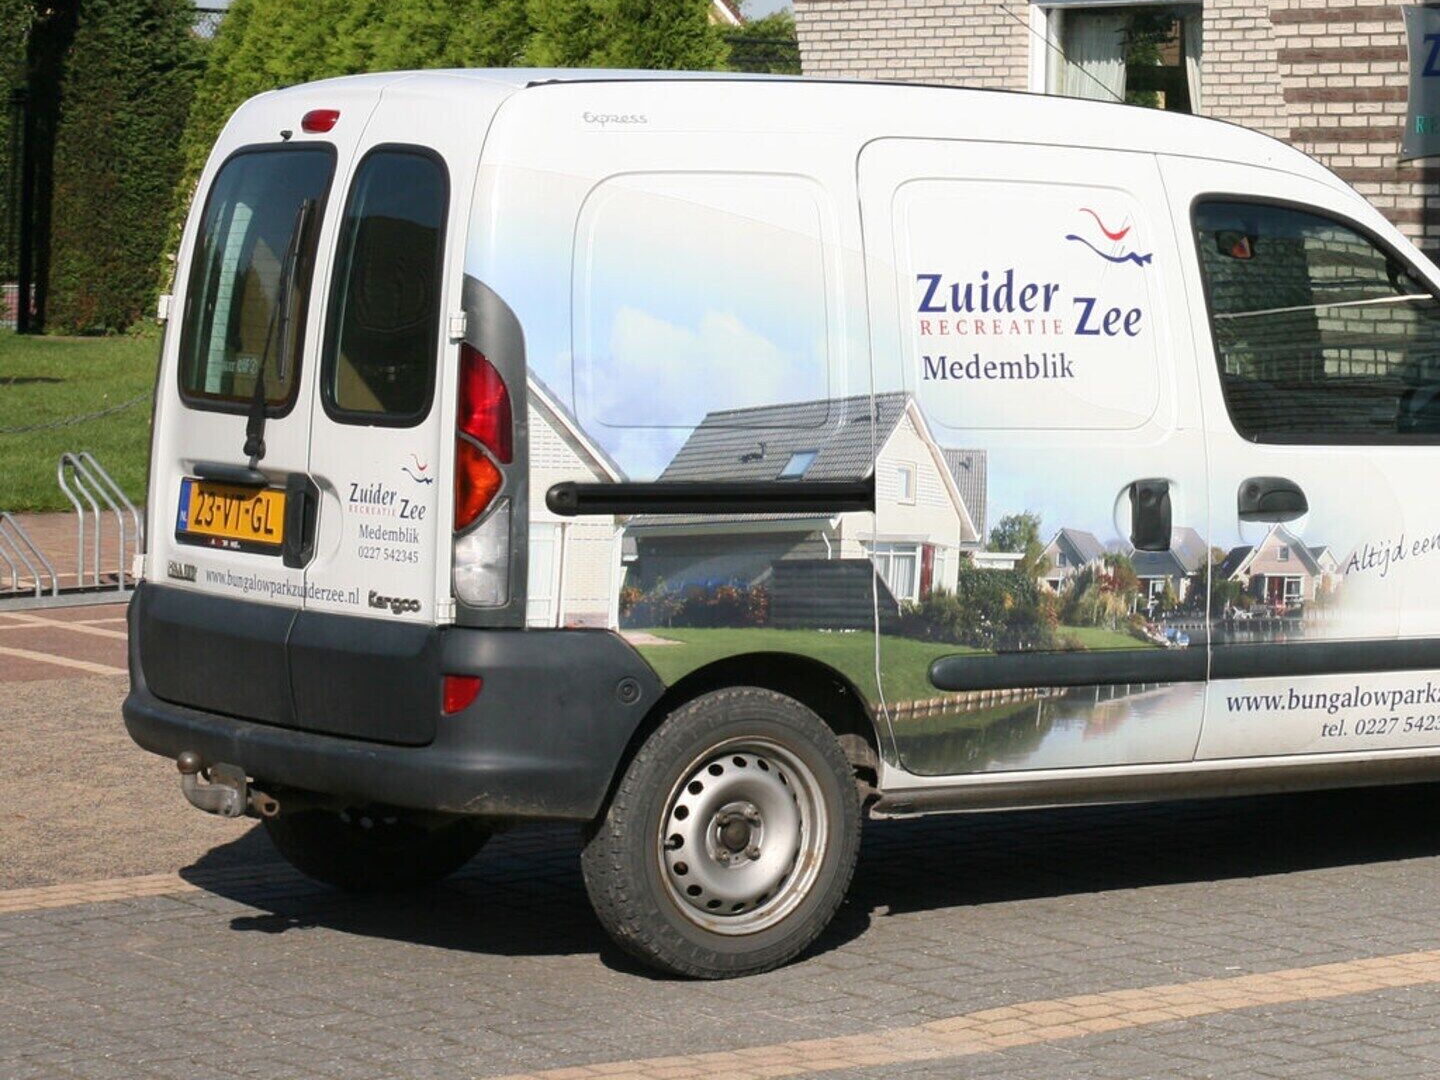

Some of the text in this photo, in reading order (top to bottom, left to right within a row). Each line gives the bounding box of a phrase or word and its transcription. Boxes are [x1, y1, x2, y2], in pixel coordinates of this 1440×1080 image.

[582, 111, 649, 128] Express
[916, 268, 1143, 337] Zuider Zee
[920, 318, 1064, 336] RECREATIE
[922, 352, 1075, 381] Medemblik
[194, 490, 274, 535] 23-VT-GL
[349, 482, 427, 520] Zuider Zee
[358, 523, 420, 544] Medemblik
[358, 545, 419, 564] 0227 542345
[1345, 533, 1406, 578] Altijd
[205, 568, 360, 605] www.bungalowparkzuiderzee.nl
[1320, 718, 1347, 738] tel.
[1354, 714, 1398, 737] 0227
